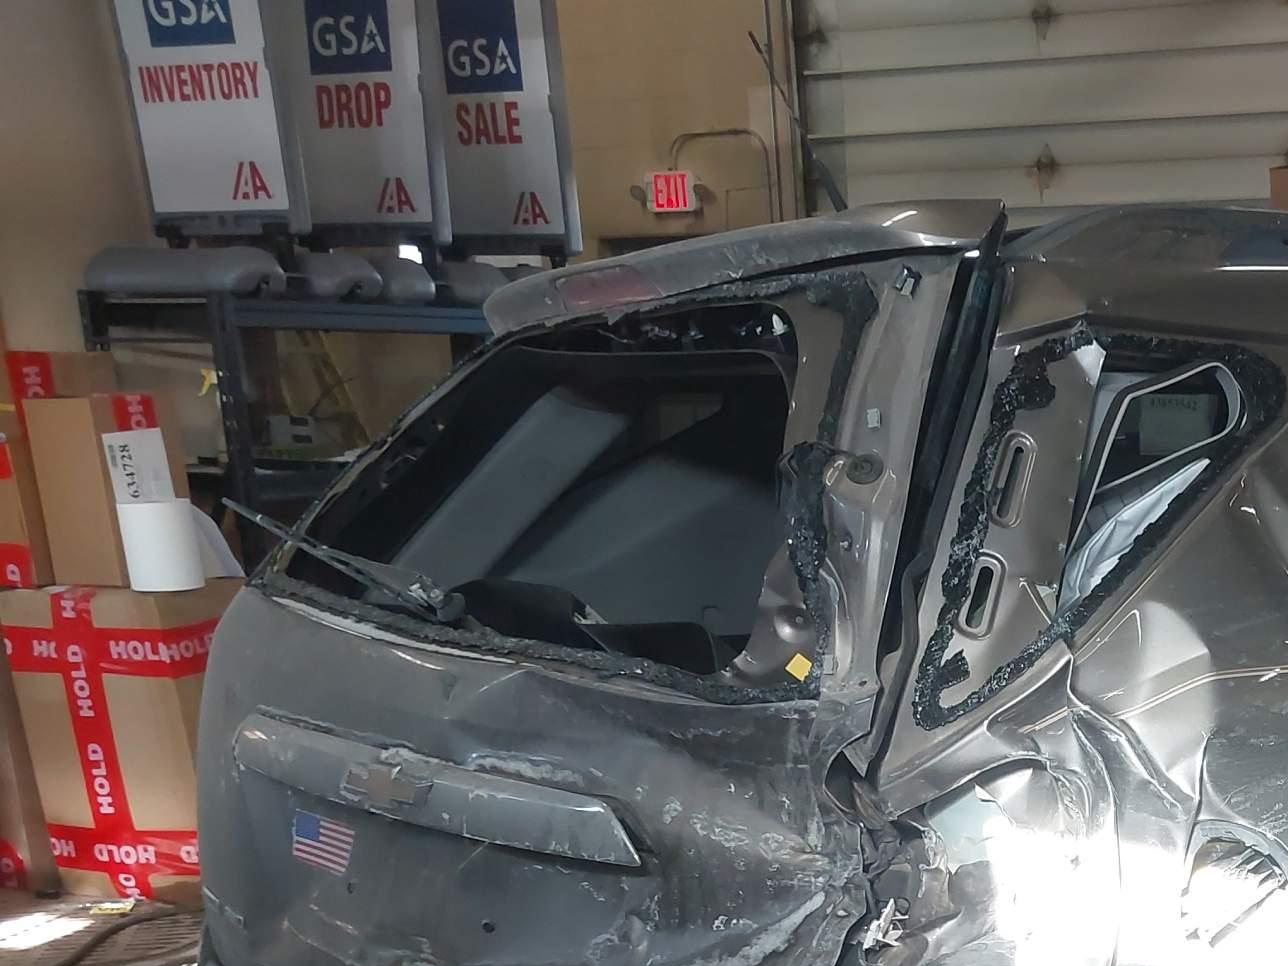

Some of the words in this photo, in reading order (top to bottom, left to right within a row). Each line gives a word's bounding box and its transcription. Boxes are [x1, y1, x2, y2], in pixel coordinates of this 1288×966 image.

[150, 0, 228, 28] GSA
[313, 14, 387, 57] GSA
[447, 38, 518, 78] GSA
[139, 61, 261, 103] INVENTORY
[315, 82, 392, 129] DROP
[456, 102, 523, 146] SALE
[653, 173, 688, 209] EXIT
[67, 644, 96, 717] HOLD
[87, 743, 116, 814] HOLD
[94, 843, 156, 864] HOLD
